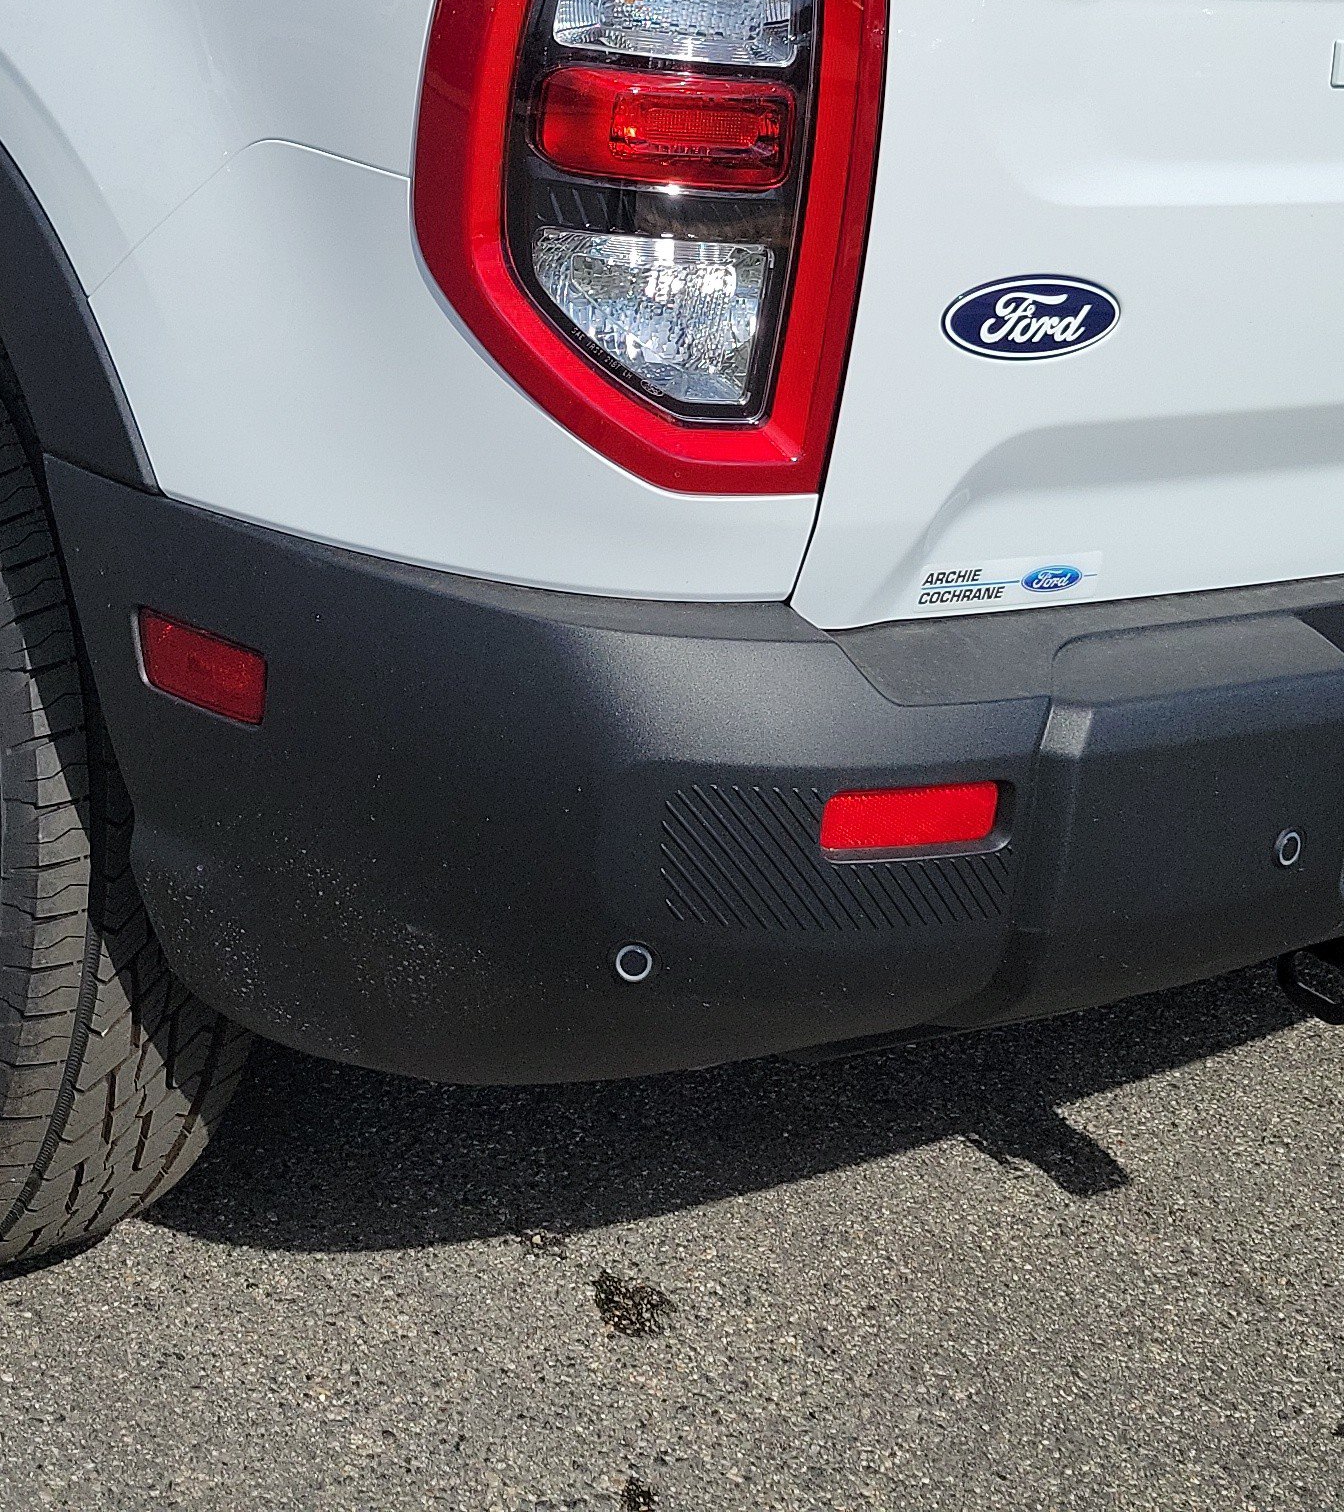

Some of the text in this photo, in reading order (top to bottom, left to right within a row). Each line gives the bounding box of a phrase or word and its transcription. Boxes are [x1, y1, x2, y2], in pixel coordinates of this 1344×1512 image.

[980, 291, 1092, 344] Ford
[921, 568, 983, 587] ARCHIE
[1031, 567, 1074, 588] Ford
[917, 586, 1006, 606] COCHRANE
